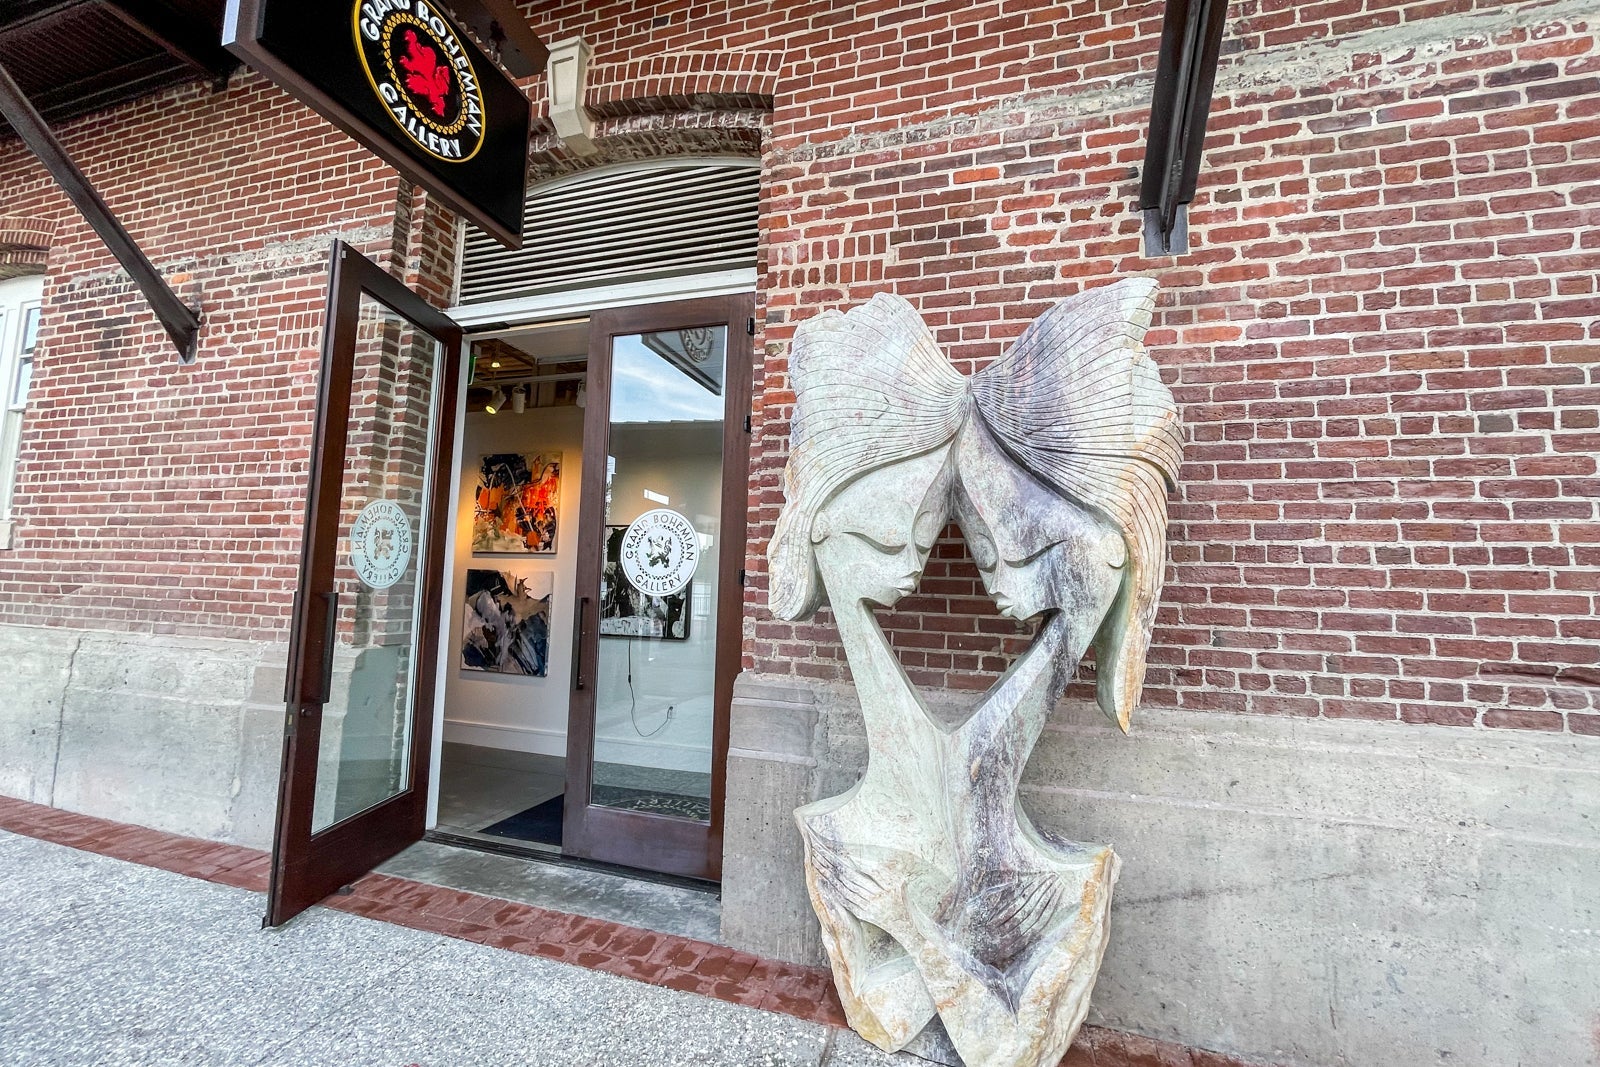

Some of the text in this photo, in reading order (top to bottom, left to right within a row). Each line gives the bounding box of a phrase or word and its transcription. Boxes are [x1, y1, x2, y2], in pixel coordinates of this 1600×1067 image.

[416, 1, 482, 137] BOHEMIAN
[379, 82, 461, 158] GALLERY
[625, 514, 694, 561] GRAND BOHEMIAN
[635, 573, 682, 591] GALLERY
